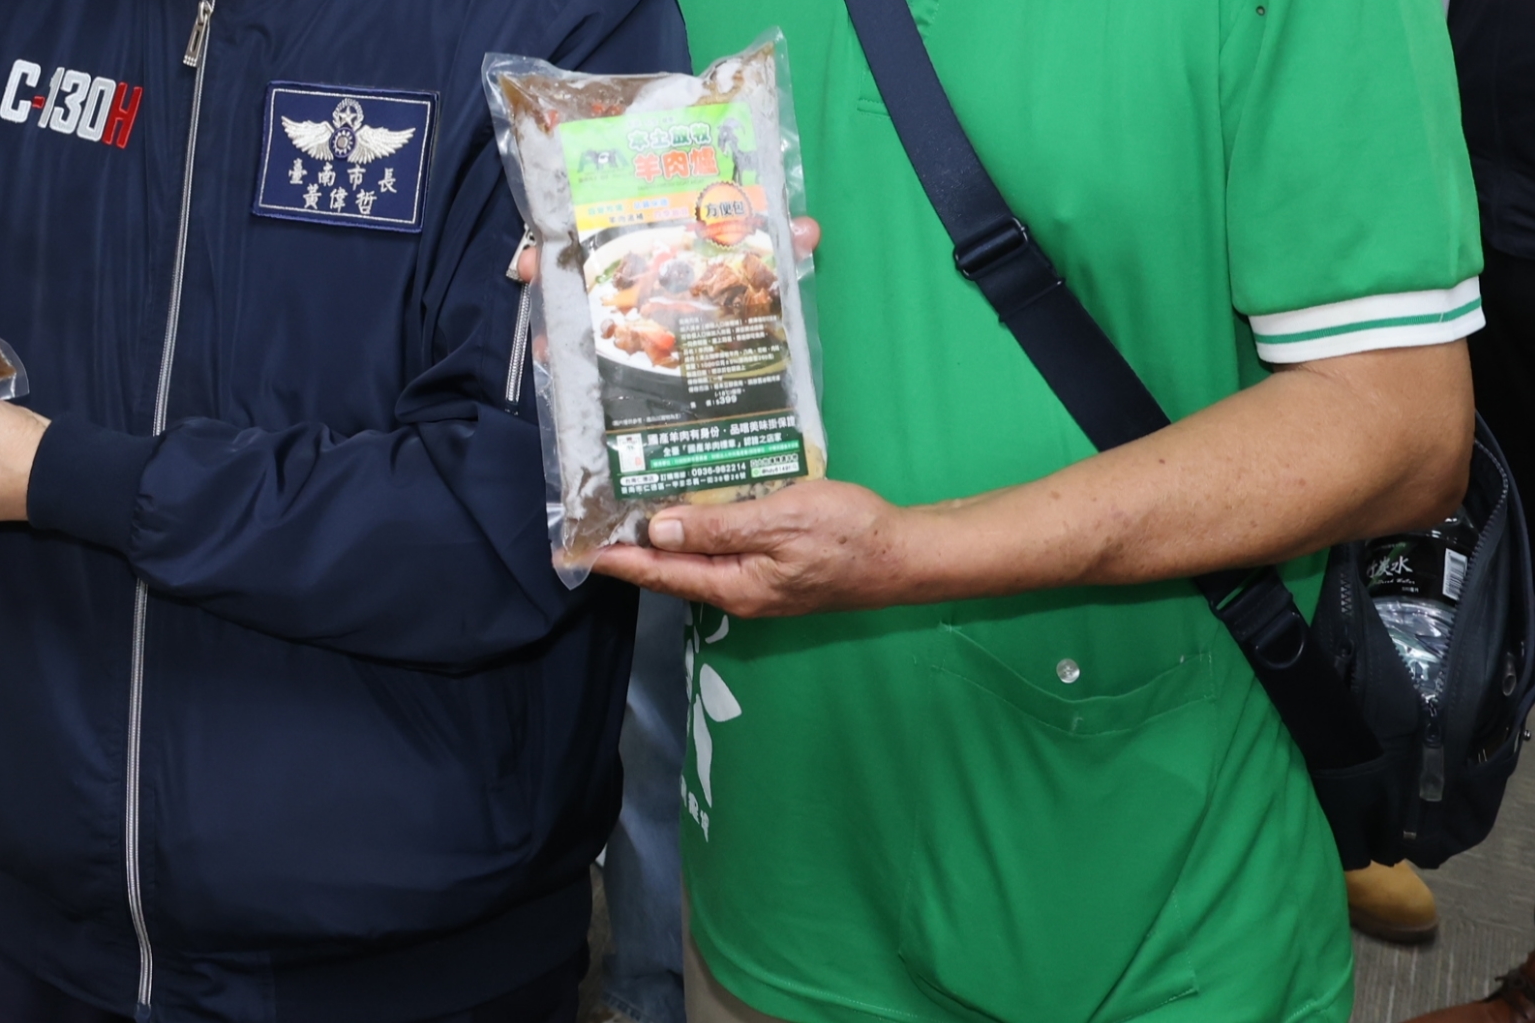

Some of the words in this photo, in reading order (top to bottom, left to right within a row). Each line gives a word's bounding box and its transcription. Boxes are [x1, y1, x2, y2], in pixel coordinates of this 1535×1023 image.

[627, 122, 712, 151] 本土放牧
[289, 159, 397, 193] 臺南市長
[633, 146, 719, 183] 羊肉爐
[303, 184, 378, 215] 黃偉哲
[705, 201, 745, 218] 方便包
